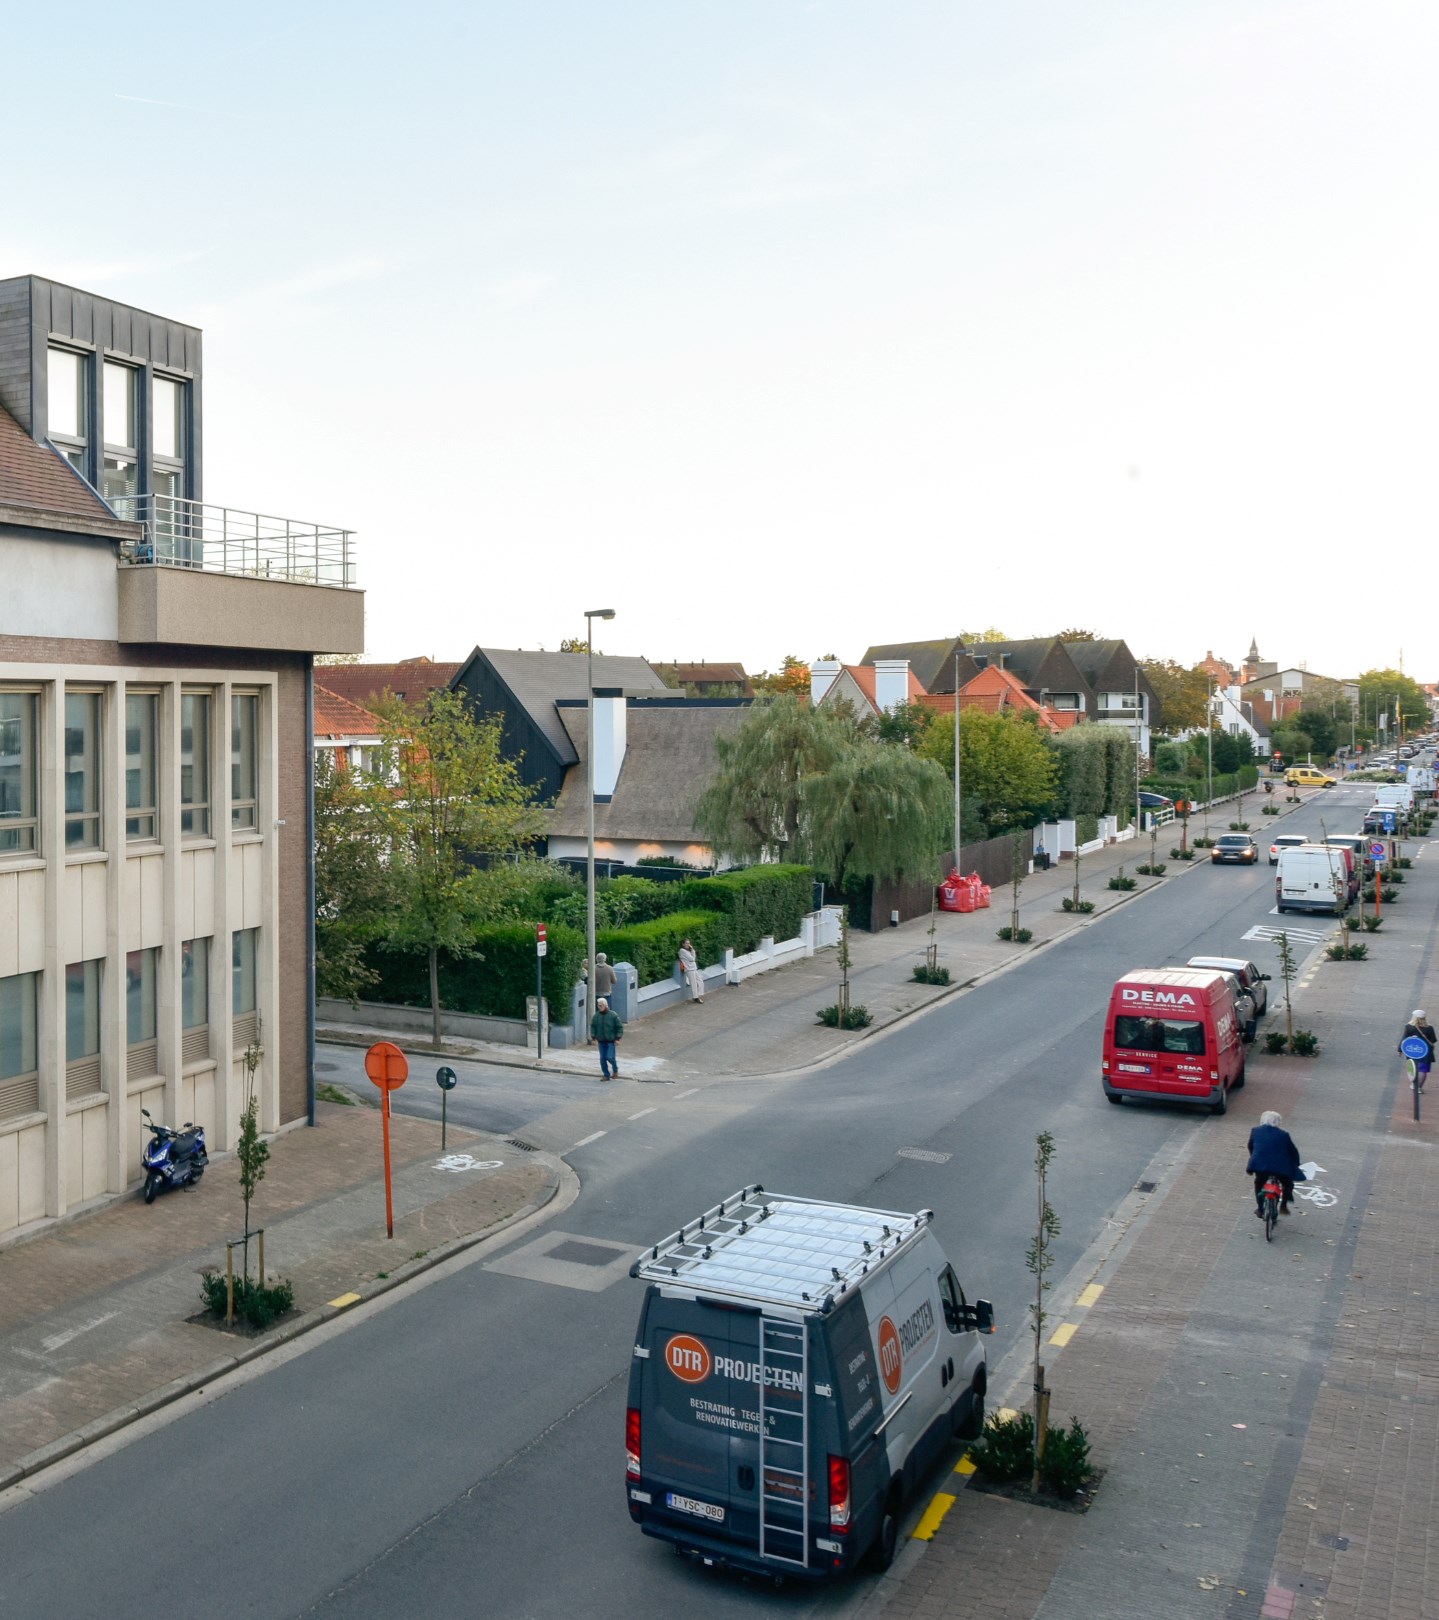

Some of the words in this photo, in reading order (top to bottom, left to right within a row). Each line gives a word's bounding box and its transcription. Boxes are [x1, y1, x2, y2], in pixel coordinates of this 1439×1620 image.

[1122, 989, 1196, 1006] DEMA
[882, 1337, 899, 1377] DTR
[898, 1298, 935, 1356] PROJECTEN
[672, 1346, 702, 1372] DTR
[714, 1355, 803, 1392] PROJECTEN
[690, 1398, 735, 1417] BESTRATING
[741, 1409, 768, 1421] TEGE-
[696, 1410, 770, 1436] RENOVATIEWERKN
